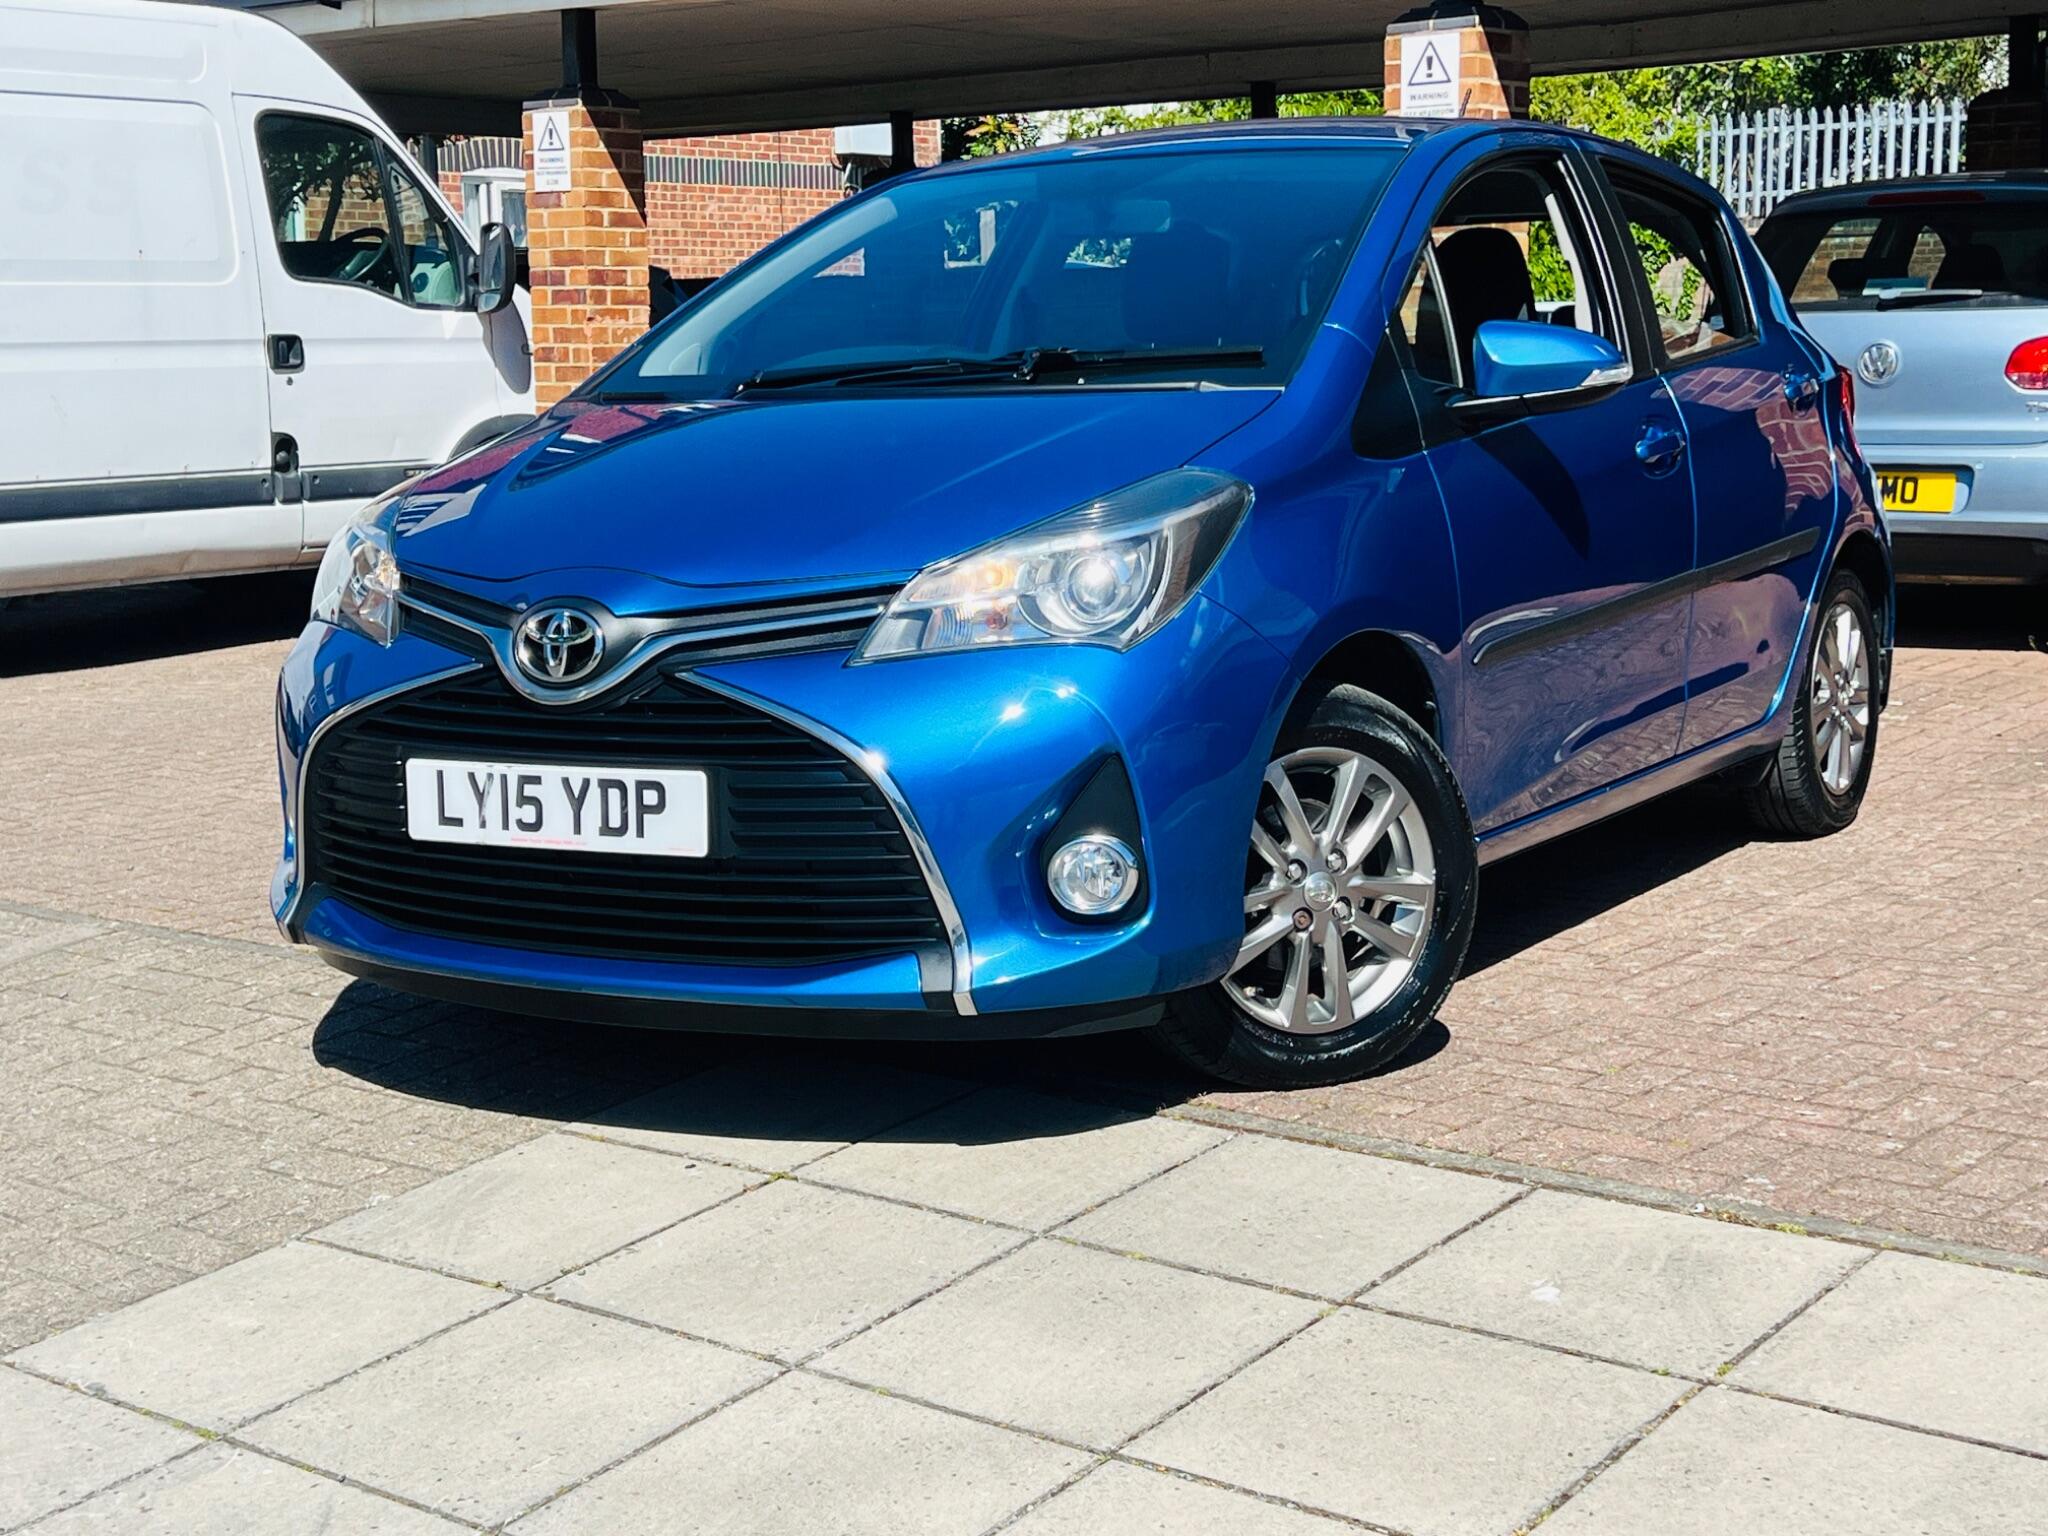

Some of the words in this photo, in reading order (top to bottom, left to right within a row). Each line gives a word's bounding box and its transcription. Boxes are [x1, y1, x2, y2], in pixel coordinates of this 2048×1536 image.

[1410, 92, 1449, 101] WARNING
[1876, 475, 1919, 505] MO
[436, 769, 544, 833] LY15
[561, 776, 667, 839] YDP
